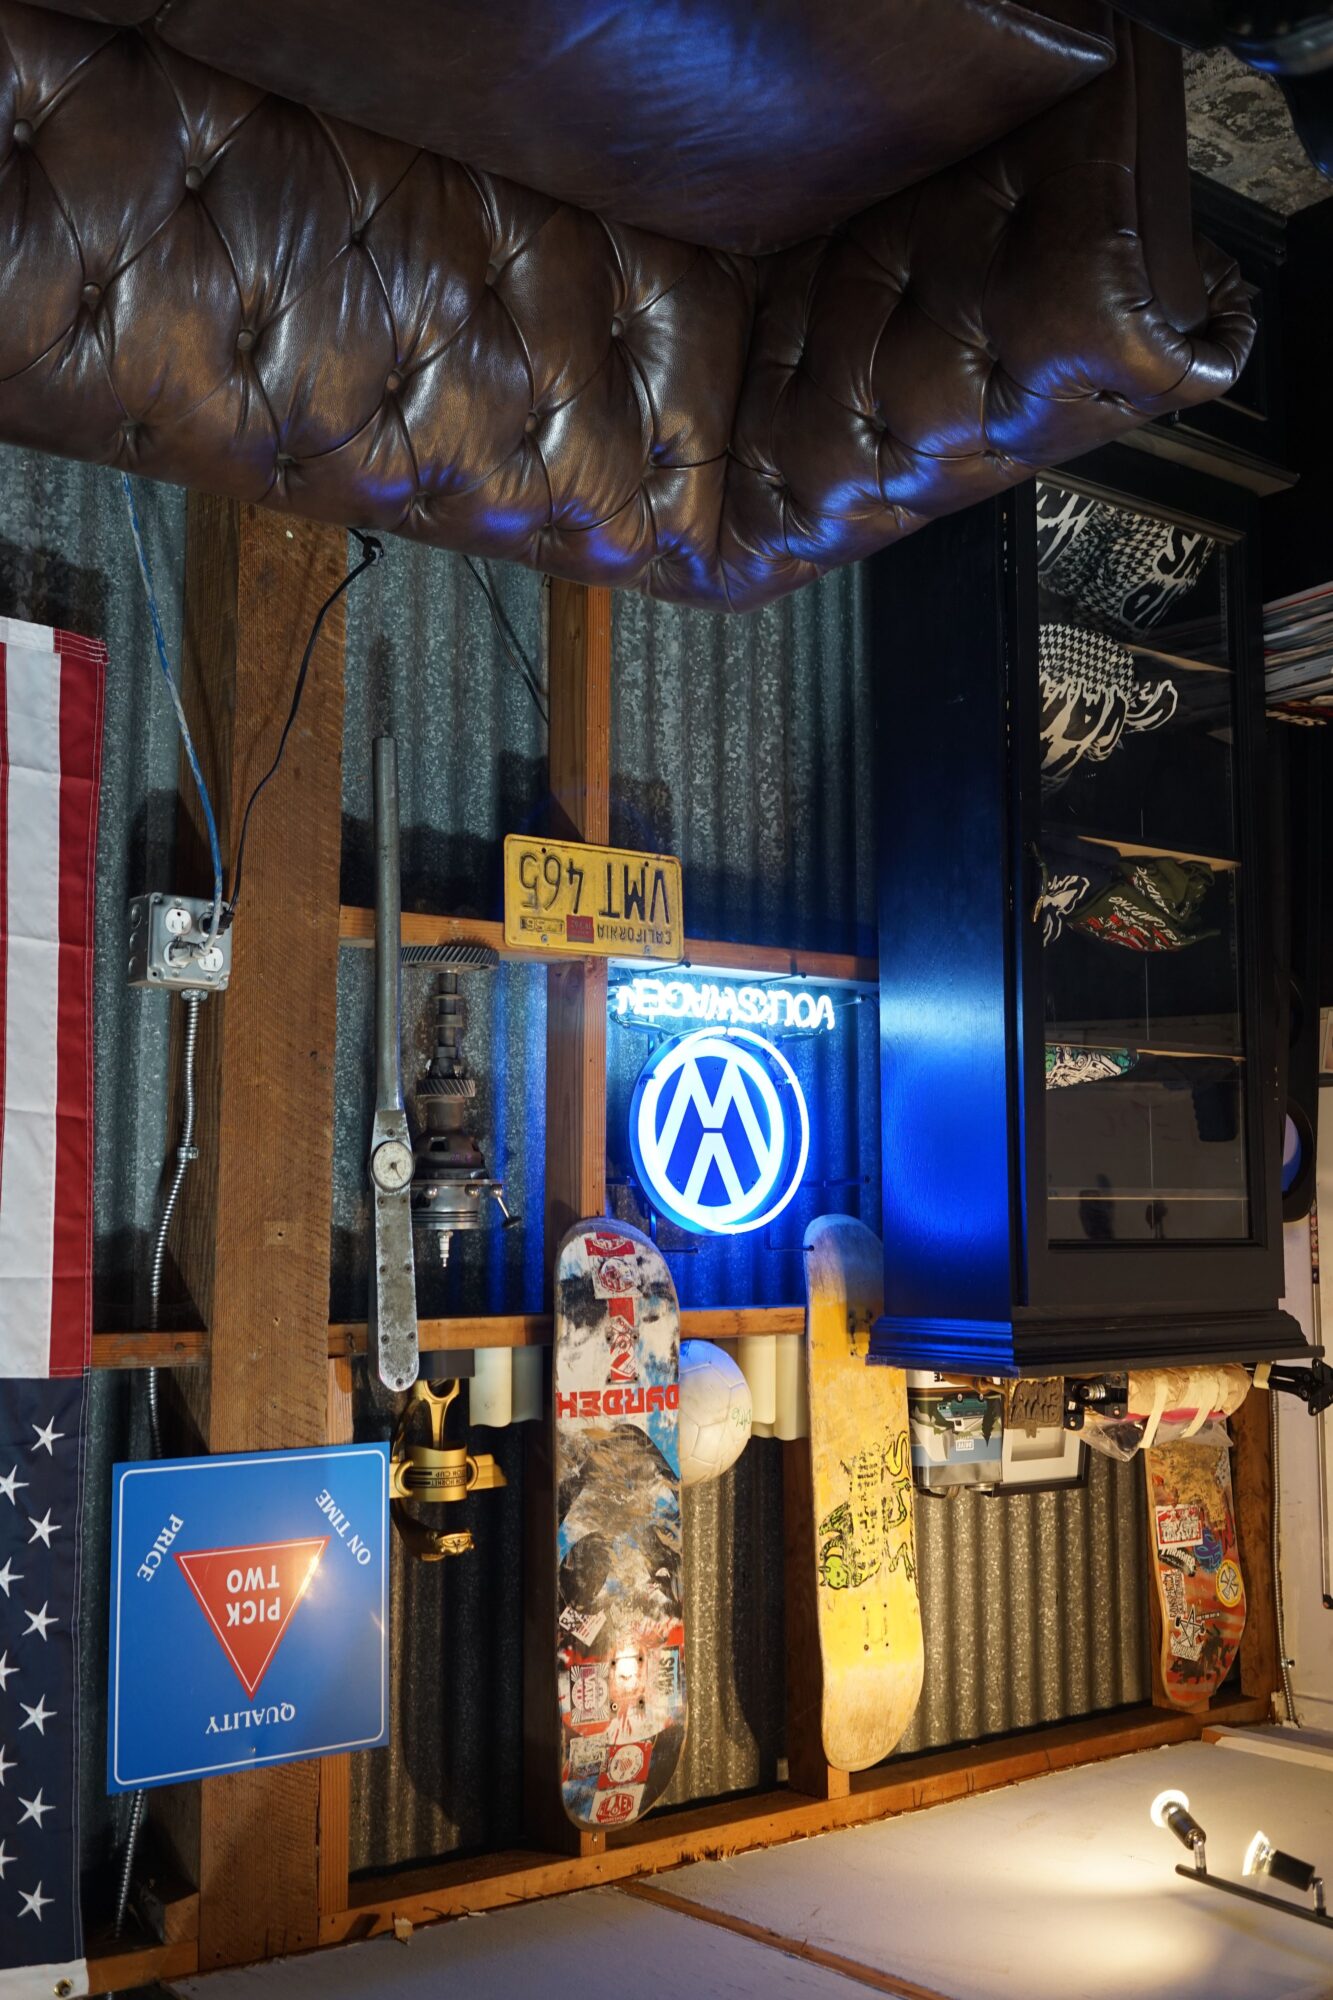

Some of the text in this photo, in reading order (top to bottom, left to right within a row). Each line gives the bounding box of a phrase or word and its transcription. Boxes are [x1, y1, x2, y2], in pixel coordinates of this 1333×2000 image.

[519, 854, 671, 925] VMT 465
[598, 924, 672, 946] CALIFORNIA
[616, 980, 836, 1031] VOLKSWAGEN
[136, 1513, 184, 1582] PRICE
[315, 1489, 372, 1566] ON TIME
[226, 1564, 281, 1594] TWO
[226, 1597, 281, 1627] PICK
[205, 1703, 296, 1735] QUALITY
